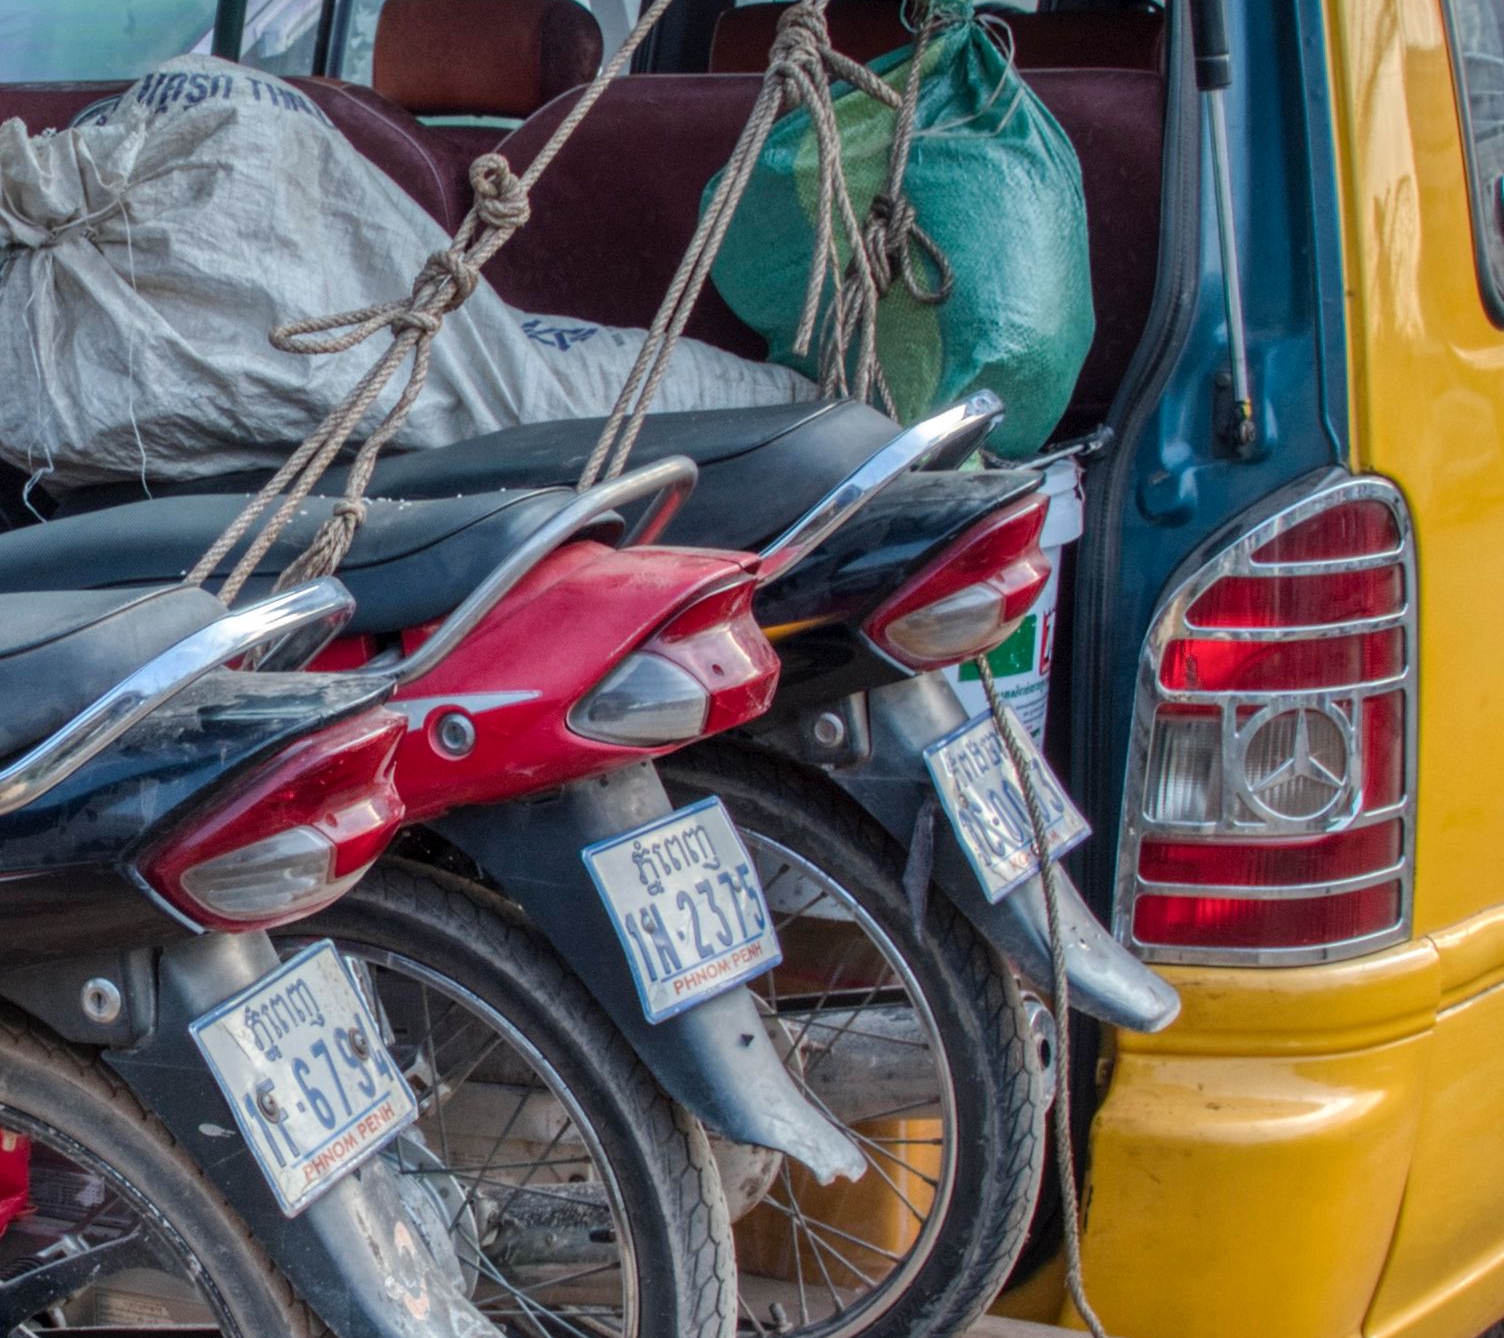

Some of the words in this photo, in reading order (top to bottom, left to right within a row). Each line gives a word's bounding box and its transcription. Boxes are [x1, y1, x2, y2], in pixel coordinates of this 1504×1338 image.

[673, 960, 731, 996] PHNOM
[731, 940, 764, 967] PENH
[302, 1134, 358, 1184] PHNOM
[357, 1102, 396, 1141] PENH
